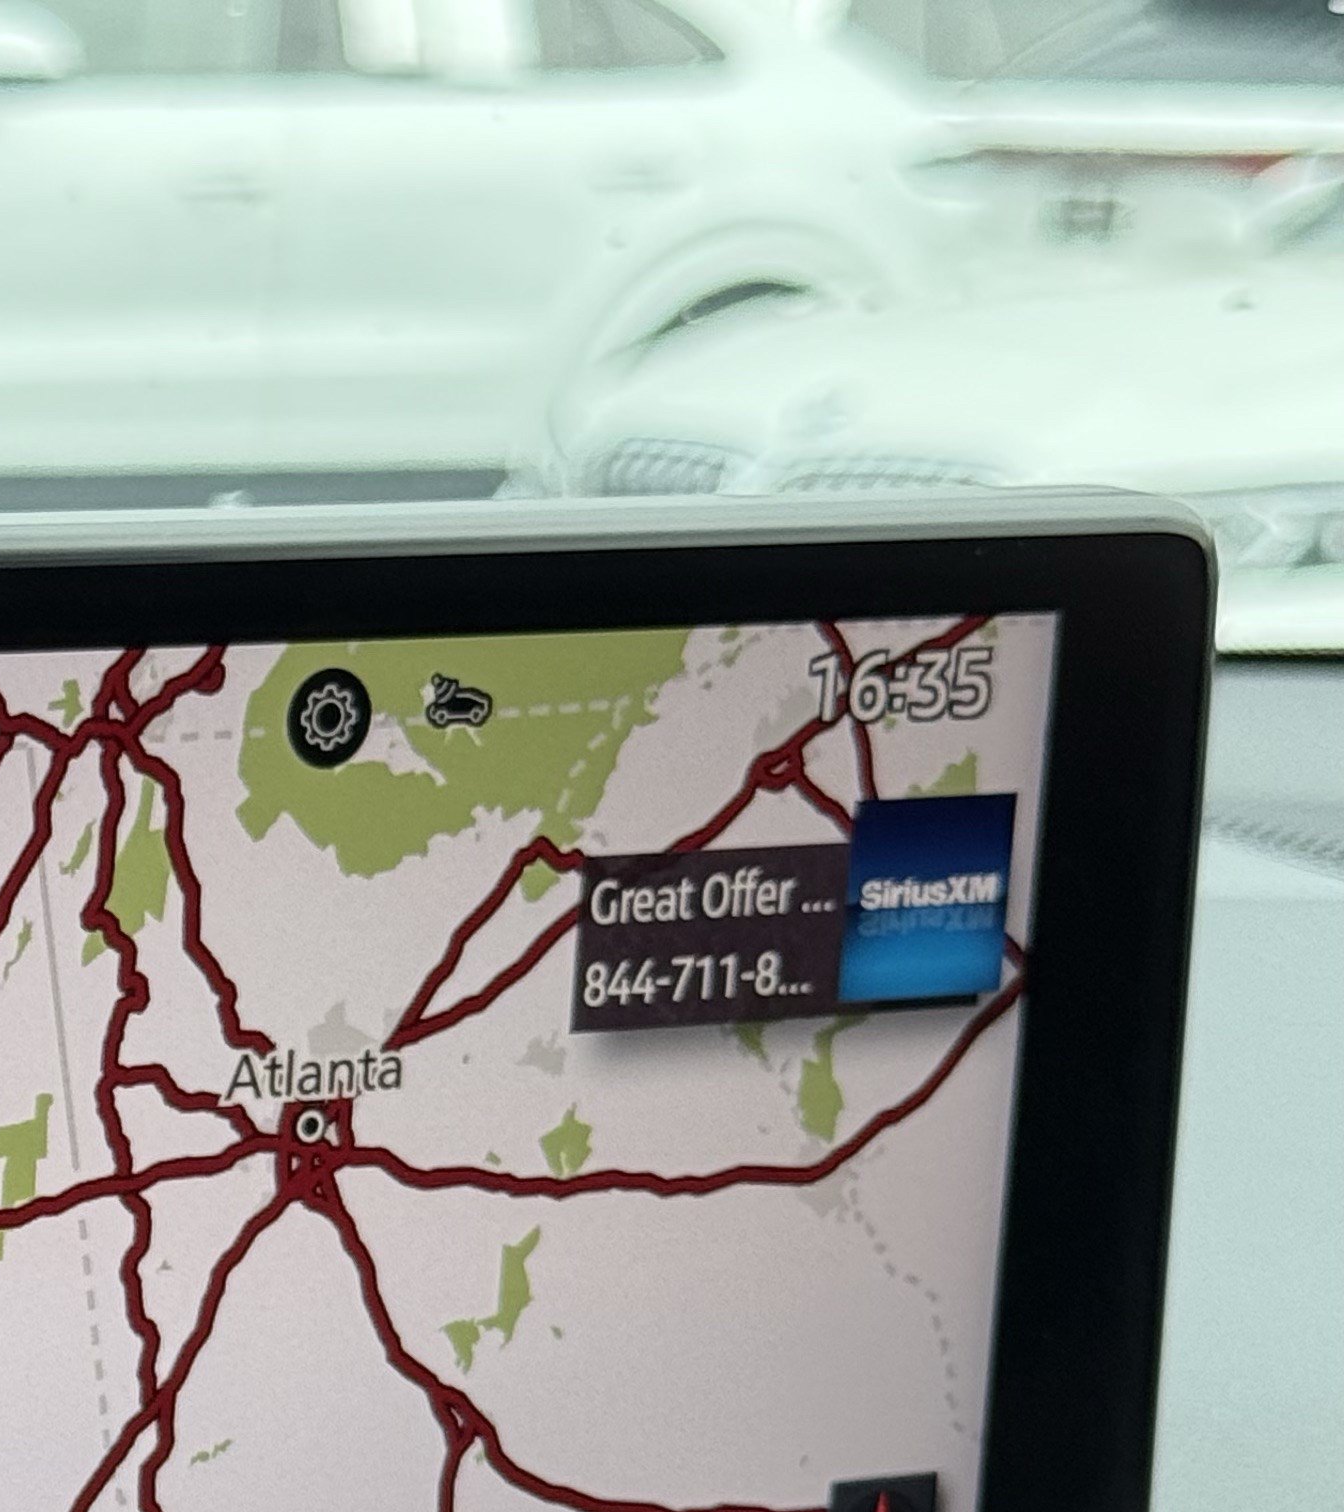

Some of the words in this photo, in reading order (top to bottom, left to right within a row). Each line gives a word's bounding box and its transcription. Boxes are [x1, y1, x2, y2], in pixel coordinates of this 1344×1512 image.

[810, 646, 994, 722] 16:35
[589, 876, 694, 926] Great
[701, 866, 798, 920] Offer
[859, 872, 1001, 911] SiriusXM
[583, 951, 813, 1008] 844-711-8...
[224, 1049, 403, 1100] Atlanta
